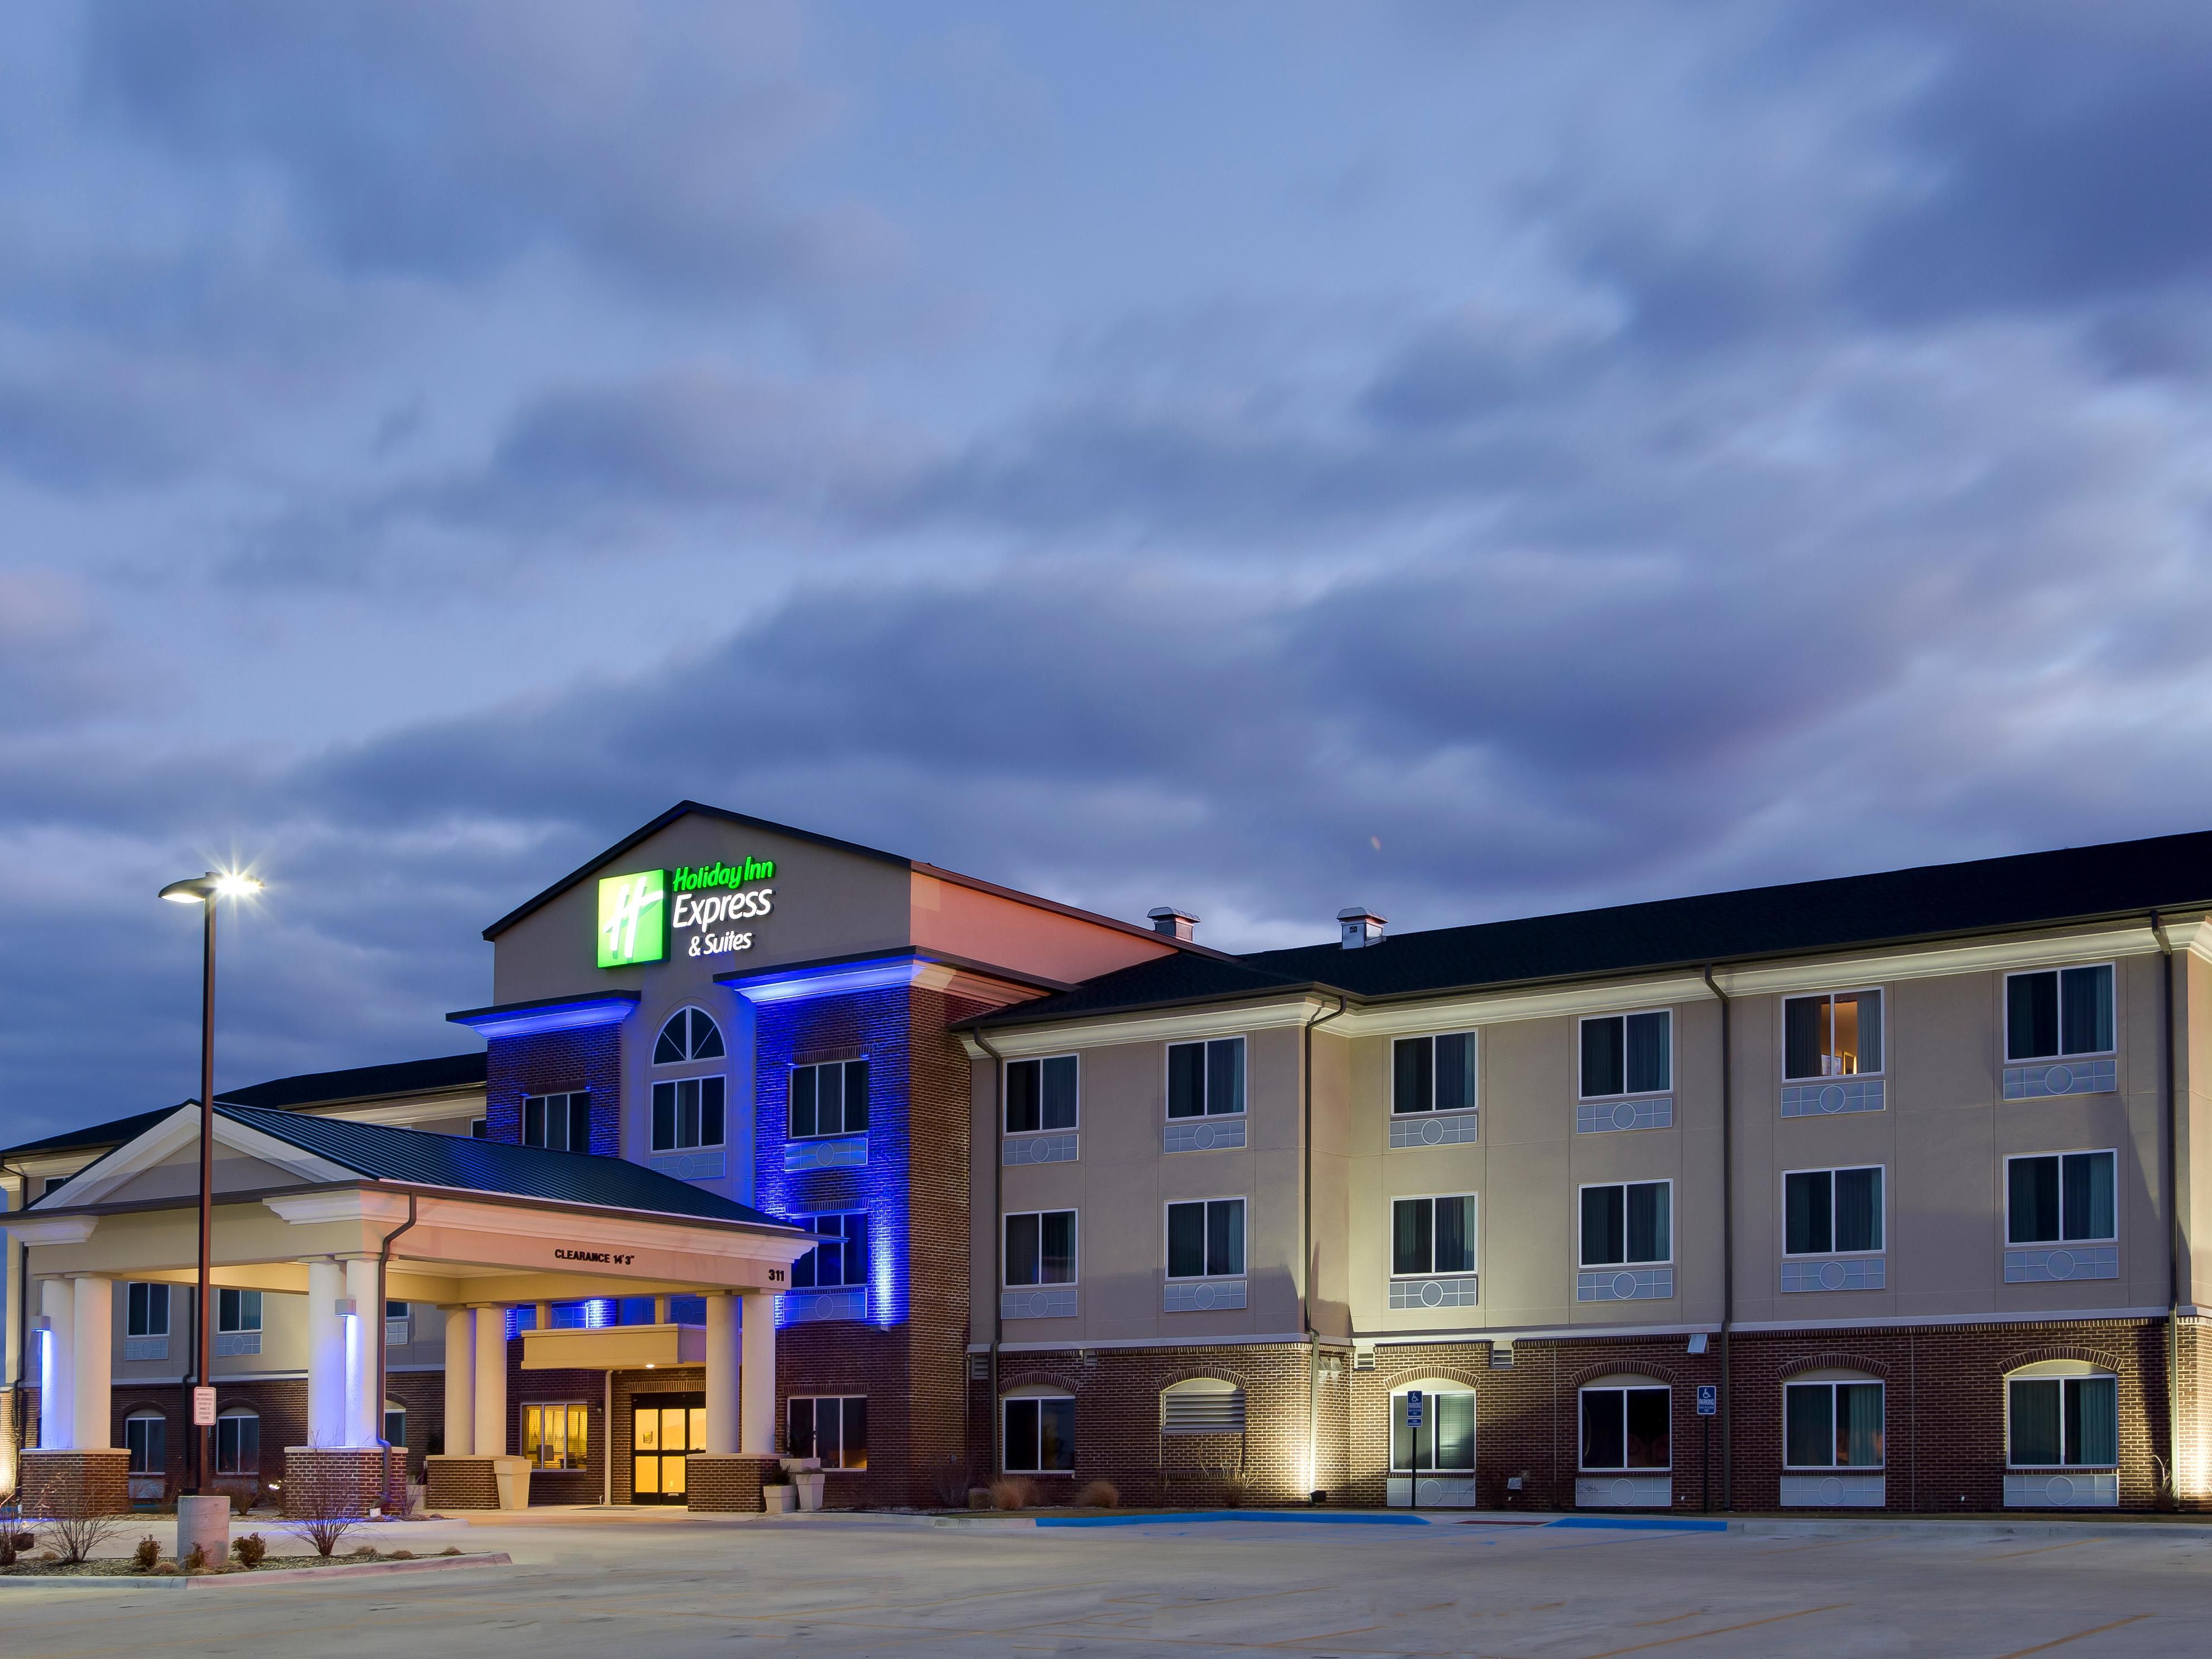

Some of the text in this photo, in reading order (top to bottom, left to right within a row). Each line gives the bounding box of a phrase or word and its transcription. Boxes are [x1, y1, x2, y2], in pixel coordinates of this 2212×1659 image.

[673, 856, 773, 892] Holiday Inn
[672, 888, 773, 933] Express
[689, 930, 753, 957] & Suites
[554, 1249, 610, 1263] CLEARANCE
[768, 1268, 785, 1282] 311
